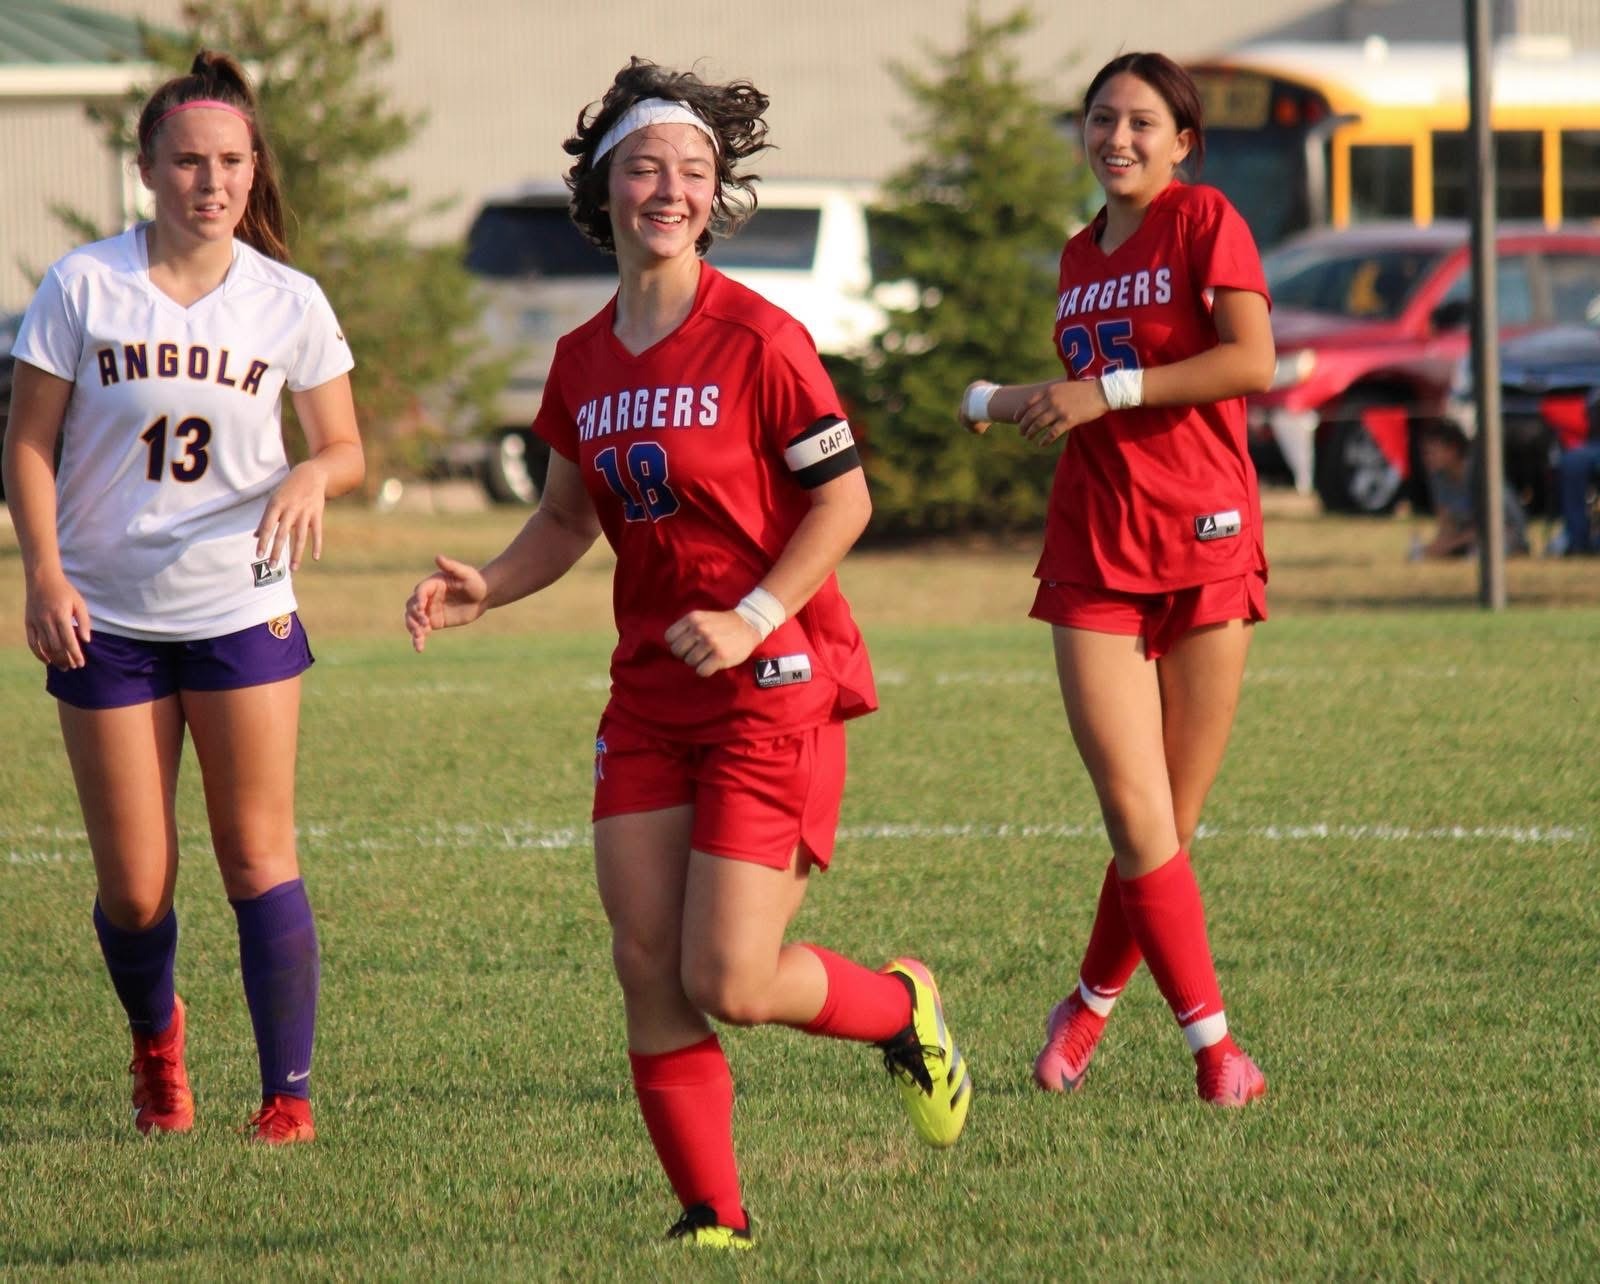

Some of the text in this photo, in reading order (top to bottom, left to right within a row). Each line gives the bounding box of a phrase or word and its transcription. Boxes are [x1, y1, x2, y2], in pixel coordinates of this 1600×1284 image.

[97, 342, 270, 396] ANGOLA
[1060, 318, 1141, 381] 25
[576, 384, 720, 443] CHARGERS
[139, 414, 213, 483] 13
[593, 441, 681, 524] 18
[791, 671, 803, 680] M
